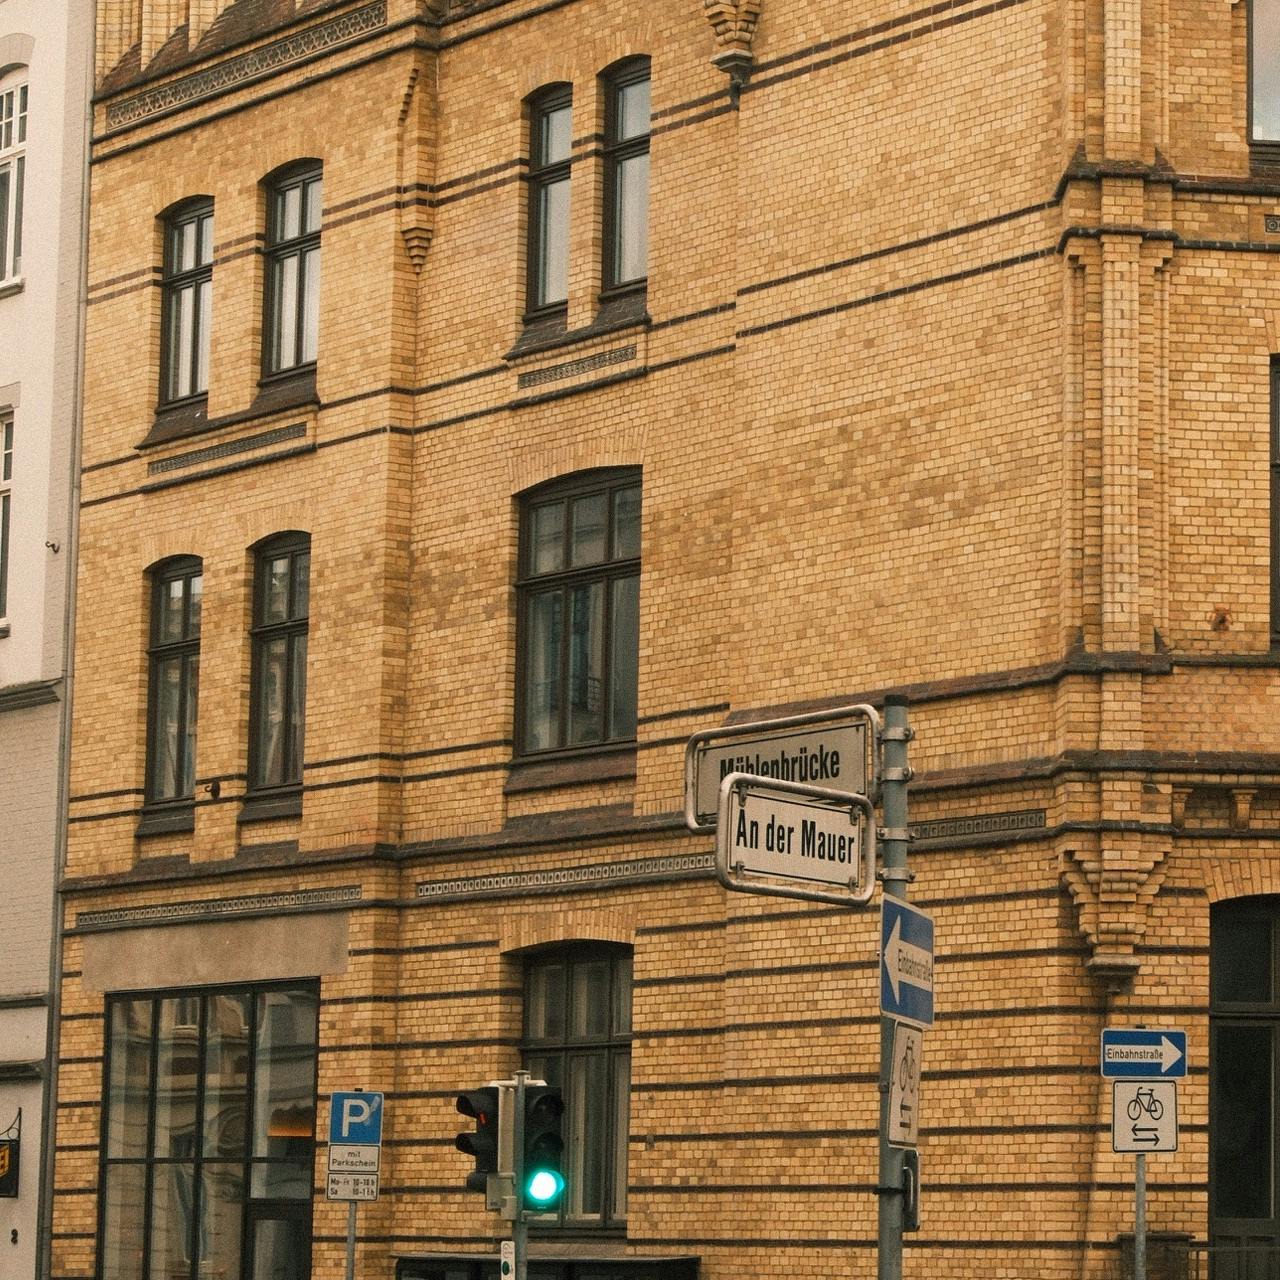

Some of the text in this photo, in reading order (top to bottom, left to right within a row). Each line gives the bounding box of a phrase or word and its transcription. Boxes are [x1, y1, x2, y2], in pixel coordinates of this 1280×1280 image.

[736, 809, 855, 864] An der Mauer
[1107, 1048, 1163, 1059] Einbahnstraße
[342, 1099, 370, 1137] P
[331, 1159, 376, 1167] Parkschein
